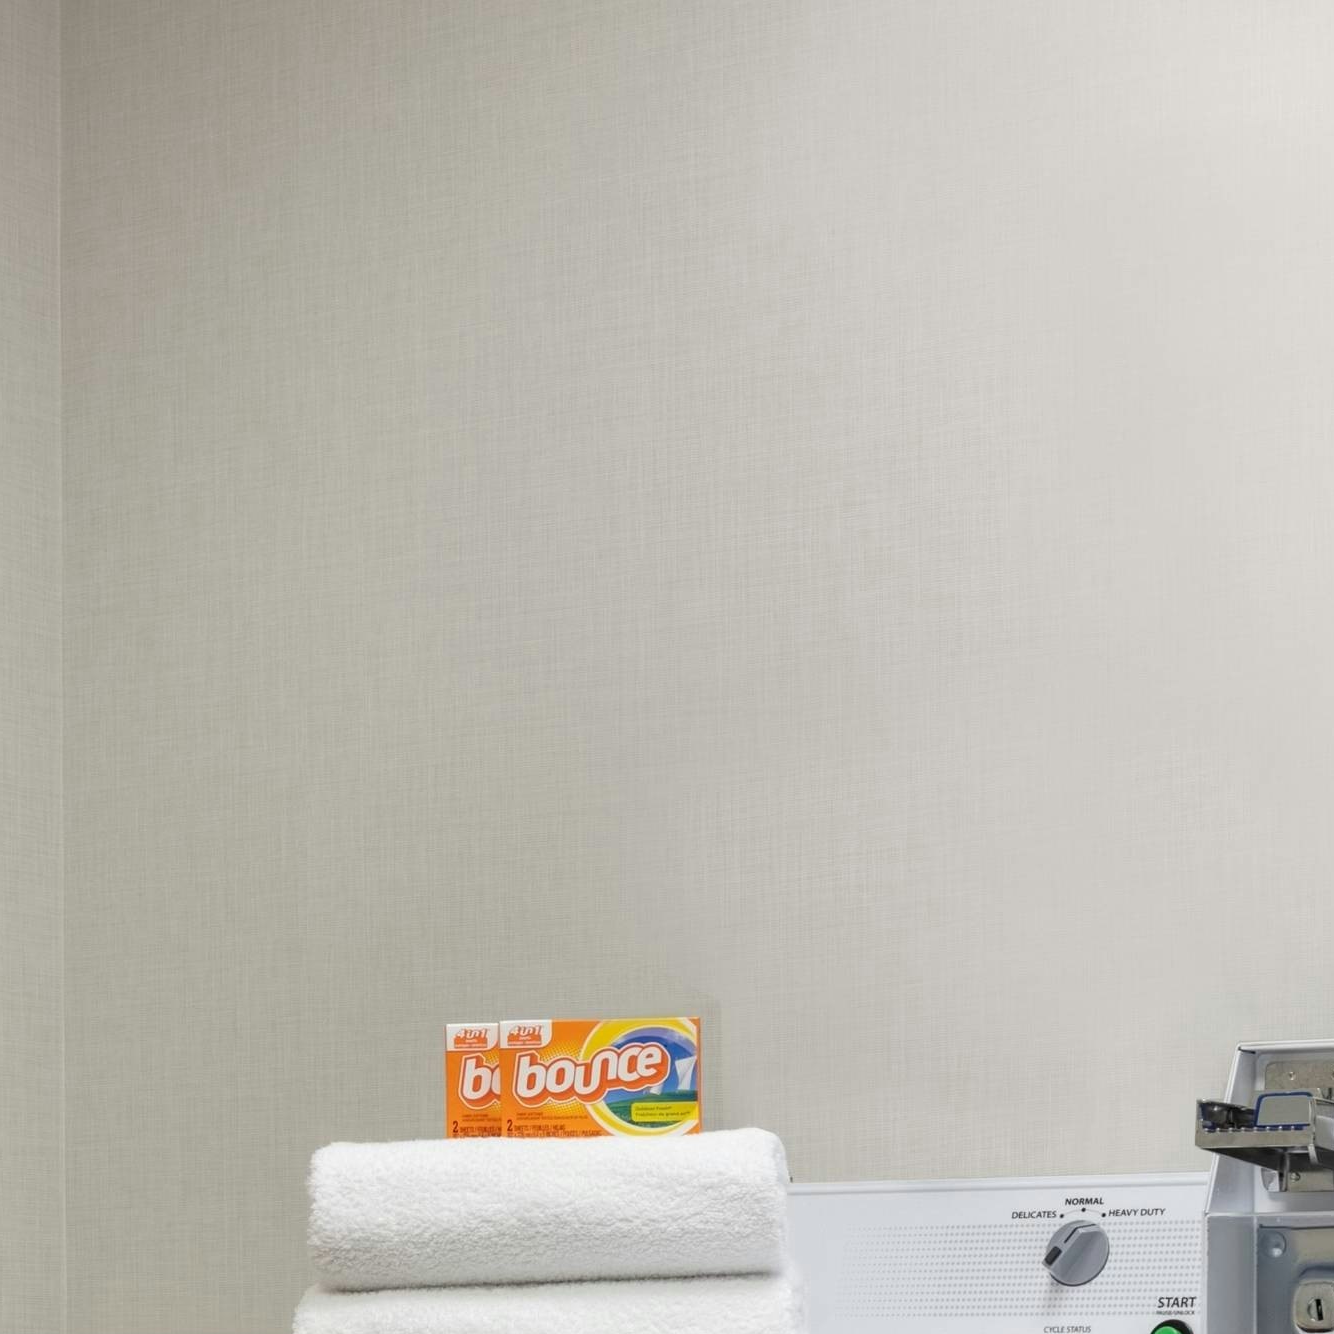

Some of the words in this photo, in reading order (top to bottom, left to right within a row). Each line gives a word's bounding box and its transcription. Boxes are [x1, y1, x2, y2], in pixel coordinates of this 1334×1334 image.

[515, 1045, 663, 1100] bounce
[452, 1120, 459, 1133] 2
[506, 1119, 513, 1132] 2
[1065, 1197, 1104, 1206] NORMAL
[1011, 1210, 1057, 1219] DELICATES
[1108, 1208, 1139, 1217] HEAVY
[1140, 1208, 1166, 1216] DUTY
[1157, 1296, 1197, 1308] START
